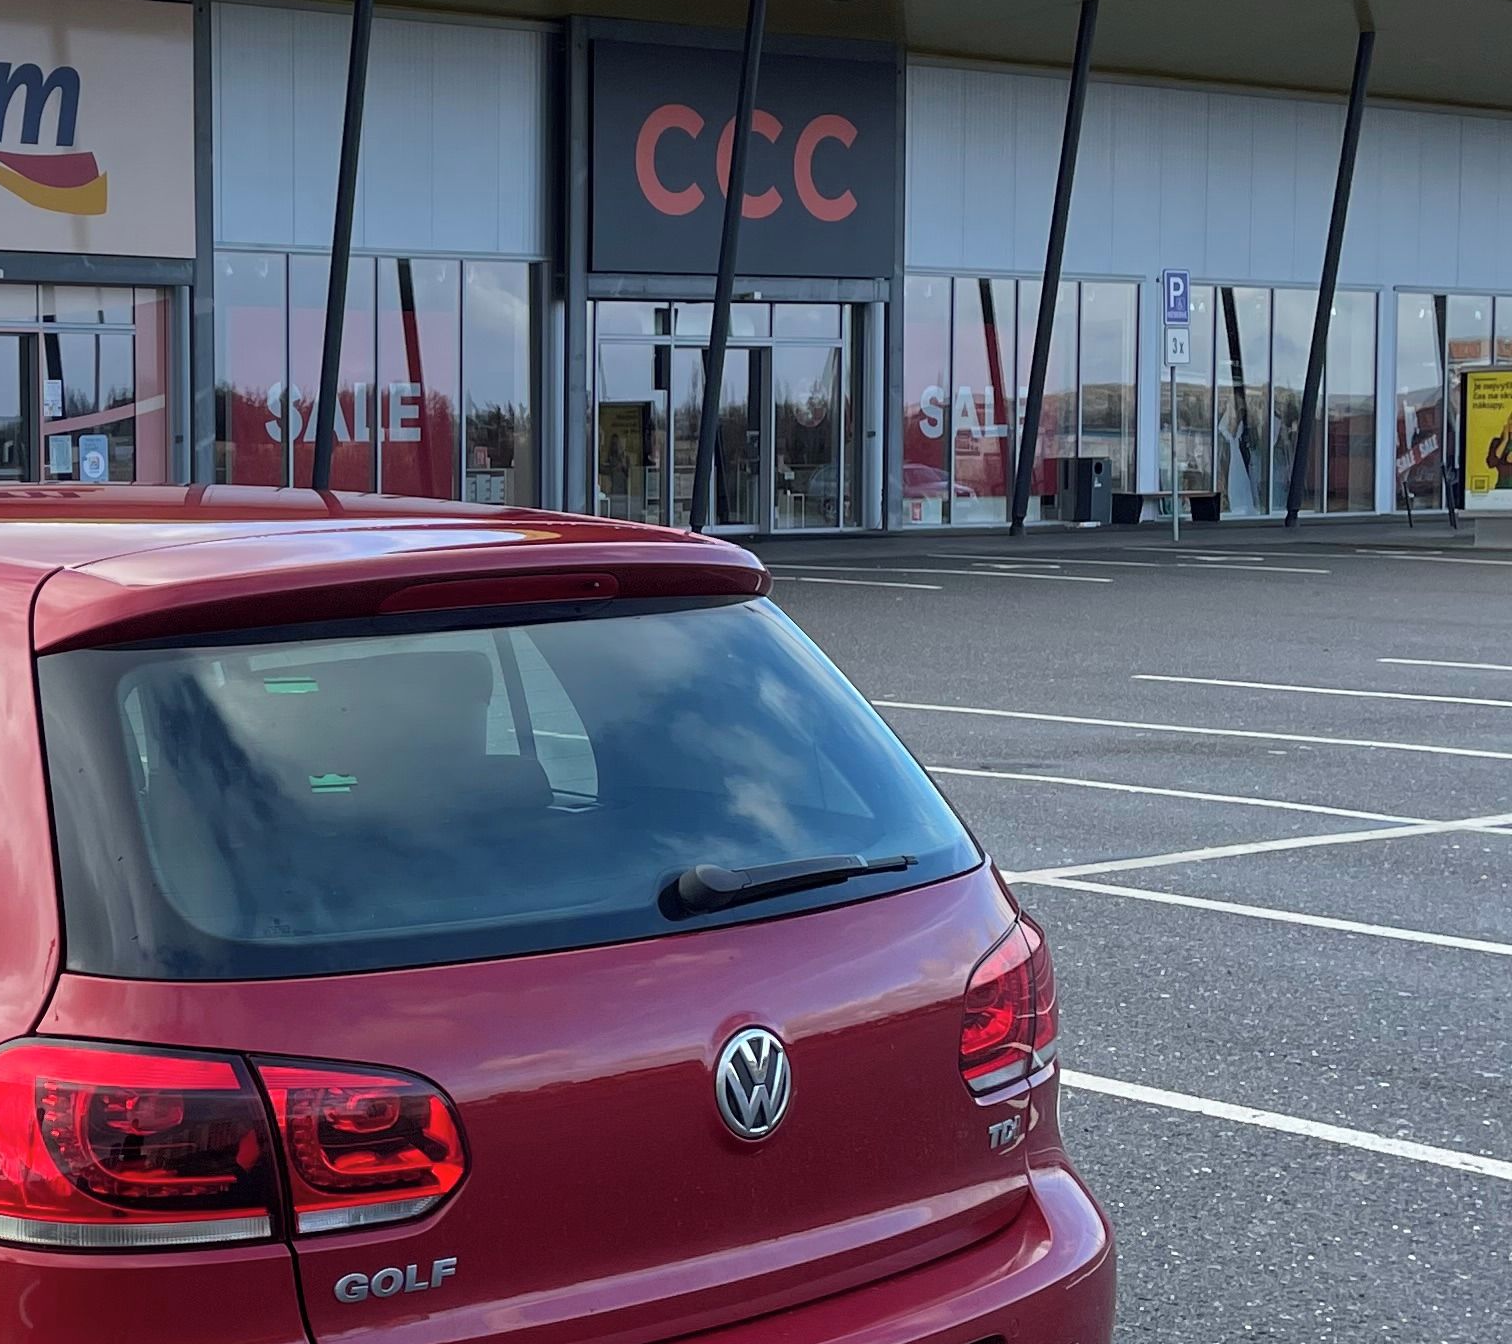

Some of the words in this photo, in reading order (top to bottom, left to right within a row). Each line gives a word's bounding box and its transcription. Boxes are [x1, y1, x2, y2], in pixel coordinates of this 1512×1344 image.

[635, 104, 858, 222] CCC
[1170, 277, 1184, 308] P
[265, 381, 421, 443] SALE
[334, 1257, 457, 1303] GOLF
